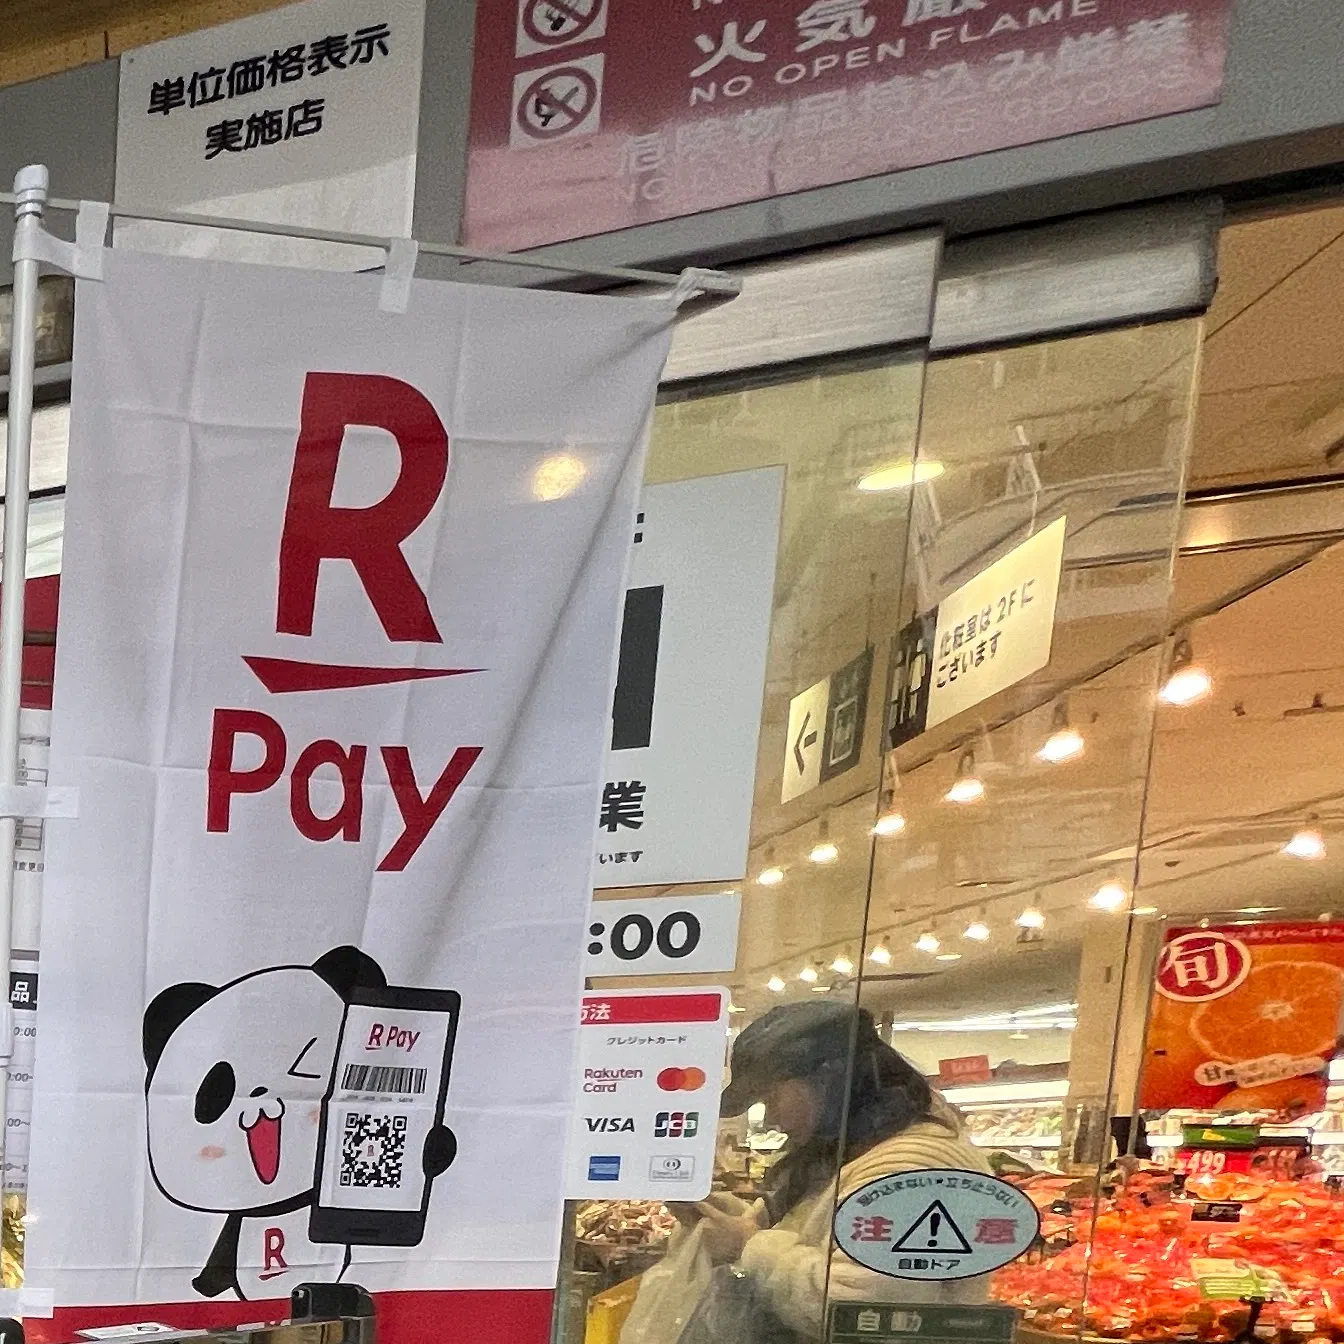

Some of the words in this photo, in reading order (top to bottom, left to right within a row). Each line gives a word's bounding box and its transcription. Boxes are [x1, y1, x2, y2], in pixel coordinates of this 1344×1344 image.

[148, 23, 390, 117] 単位価格表示
[689, 76, 753, 105] NO
[775, 38, 907, 84] OPEN
[929, 0, 1099, 49] FLAME
[204, 98, 326, 160] 実施店
[276, 371, 449, 644] R
[206, 708, 485, 872] Pay
[1169, 941, 1230, 989] 旬
[386, 1025, 421, 1052] Pay
[606, 1035, 688, 1046] クレジットカード
[583, 1083, 617, 1094] Card
[584, 1067, 644, 1080] Rakuten
[584, 1117, 636, 1133] VISA
[262, 1227, 288, 1271] R
[850, 1215, 894, 1242] 注
